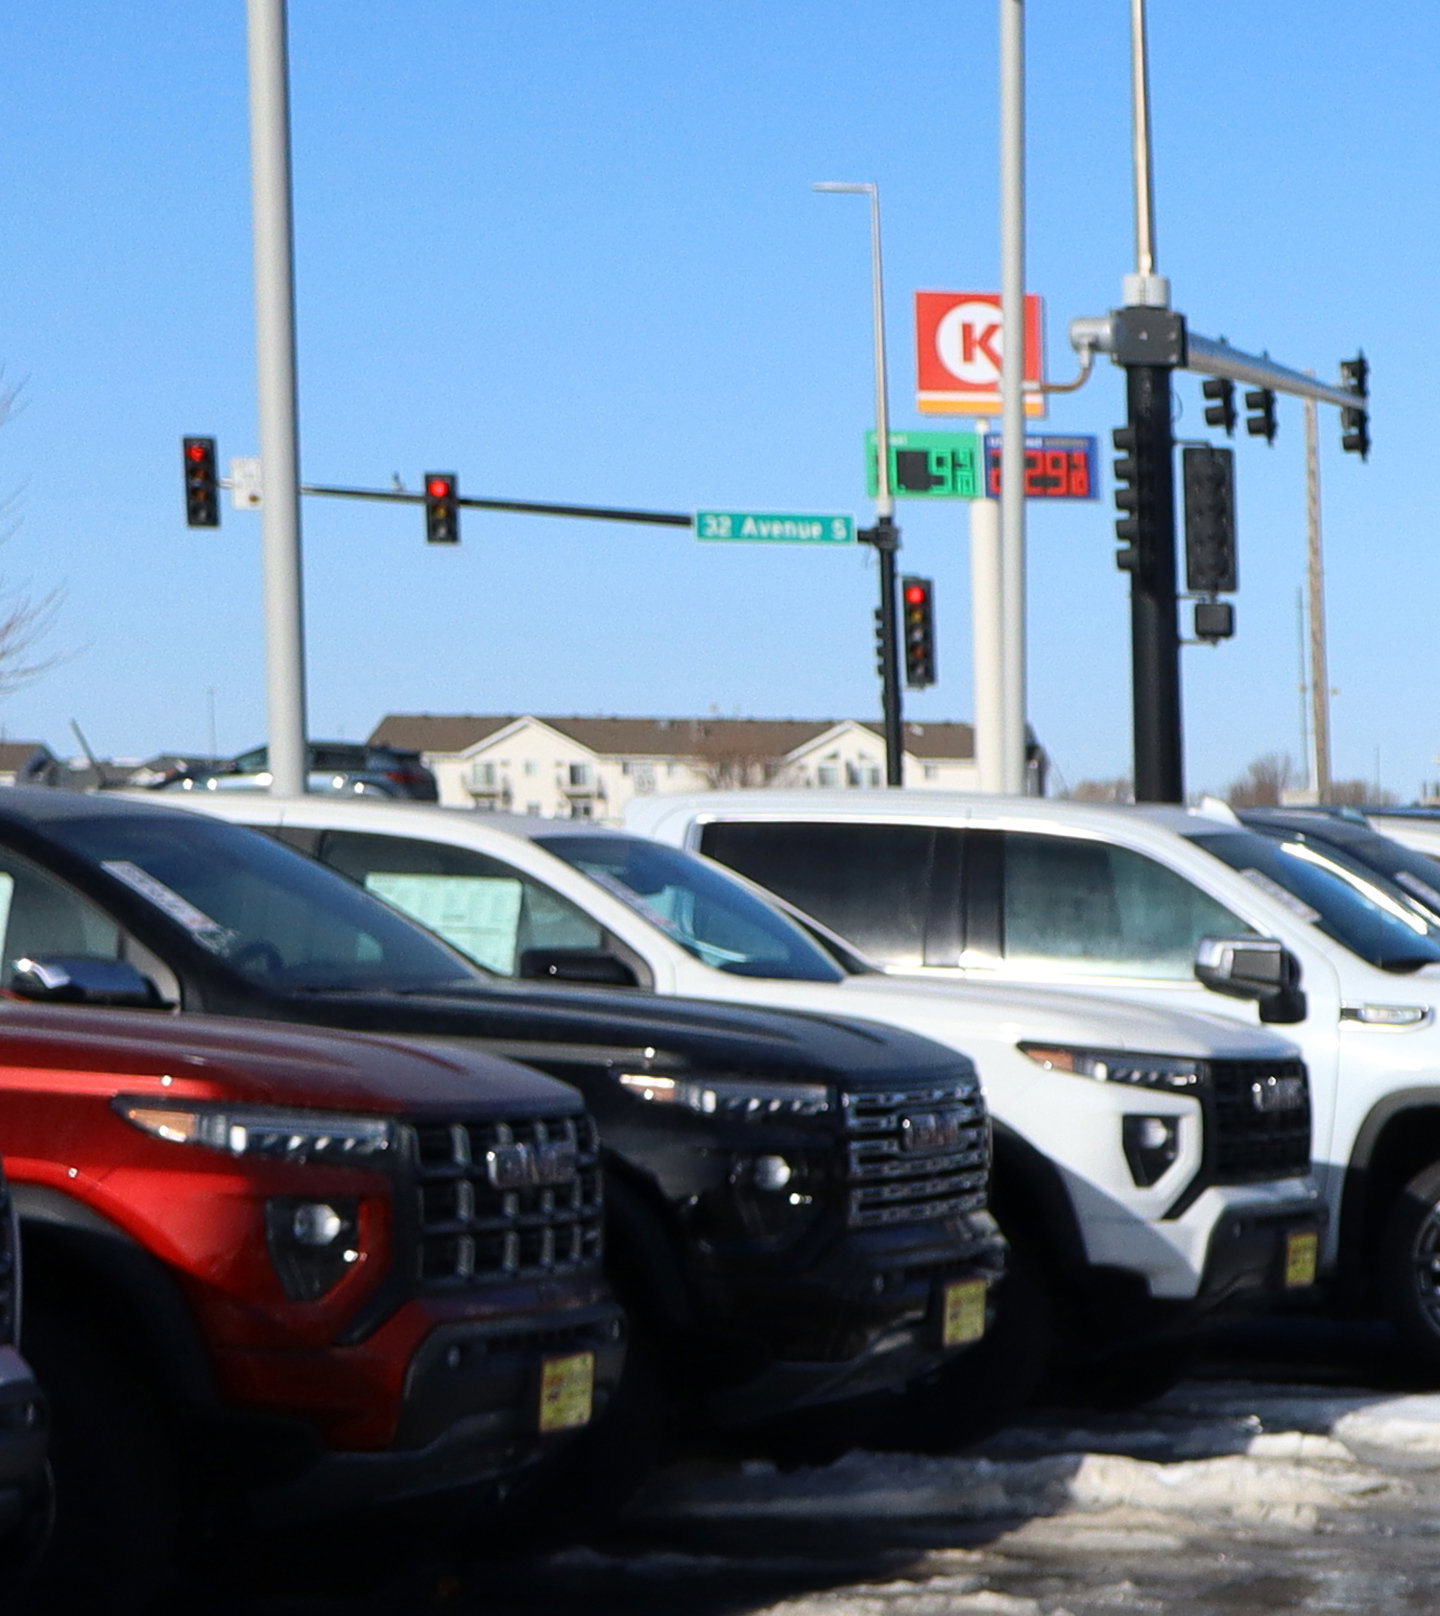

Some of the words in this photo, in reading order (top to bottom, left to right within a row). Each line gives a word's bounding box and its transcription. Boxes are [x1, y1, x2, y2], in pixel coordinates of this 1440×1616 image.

[961, 322, 1003, 376] K
[704, 513, 733, 537] 32
[740, 515, 824, 540] Avenue
[830, 517, 848, 541] S
